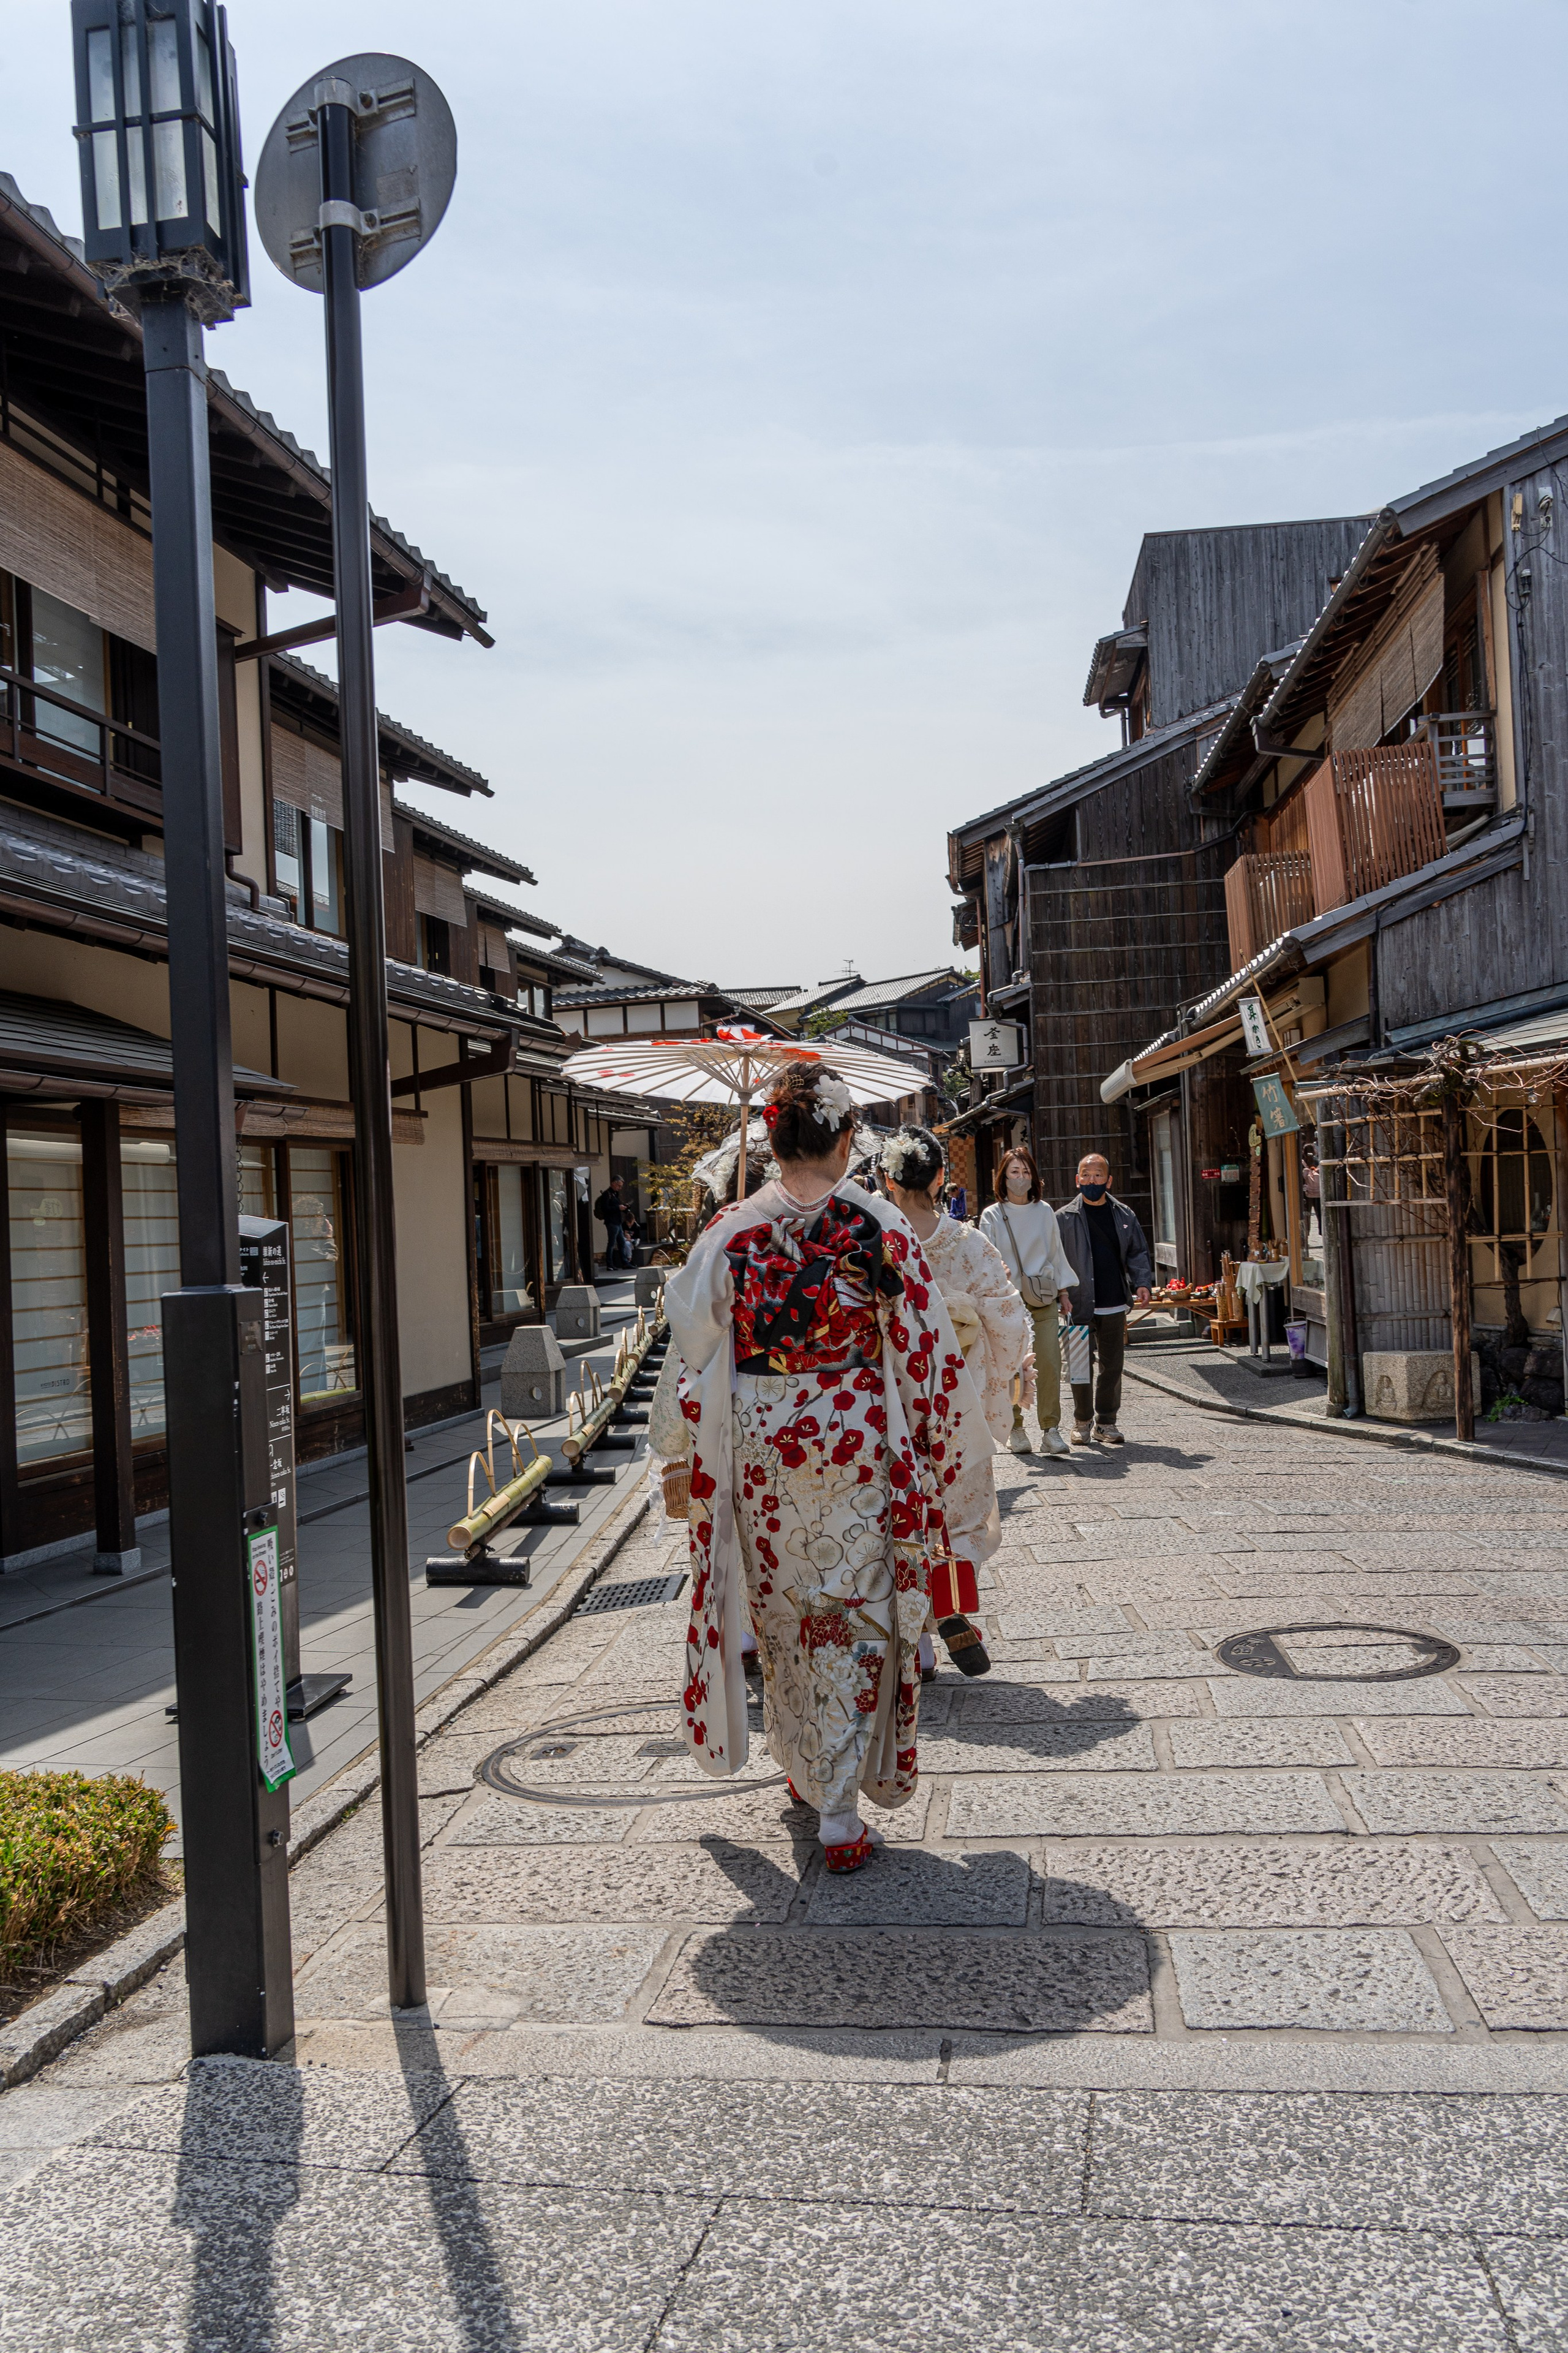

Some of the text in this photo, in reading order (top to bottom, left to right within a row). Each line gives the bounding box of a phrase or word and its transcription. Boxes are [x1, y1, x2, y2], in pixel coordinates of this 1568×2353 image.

[984, 1027, 1001, 1056] 釜座
[1262, 1082, 1286, 1130] 竹箸
[262, 1245, 282, 1257] 維新の道
[256, 1601, 269, 1769] 路上喫煙はやめましょう
